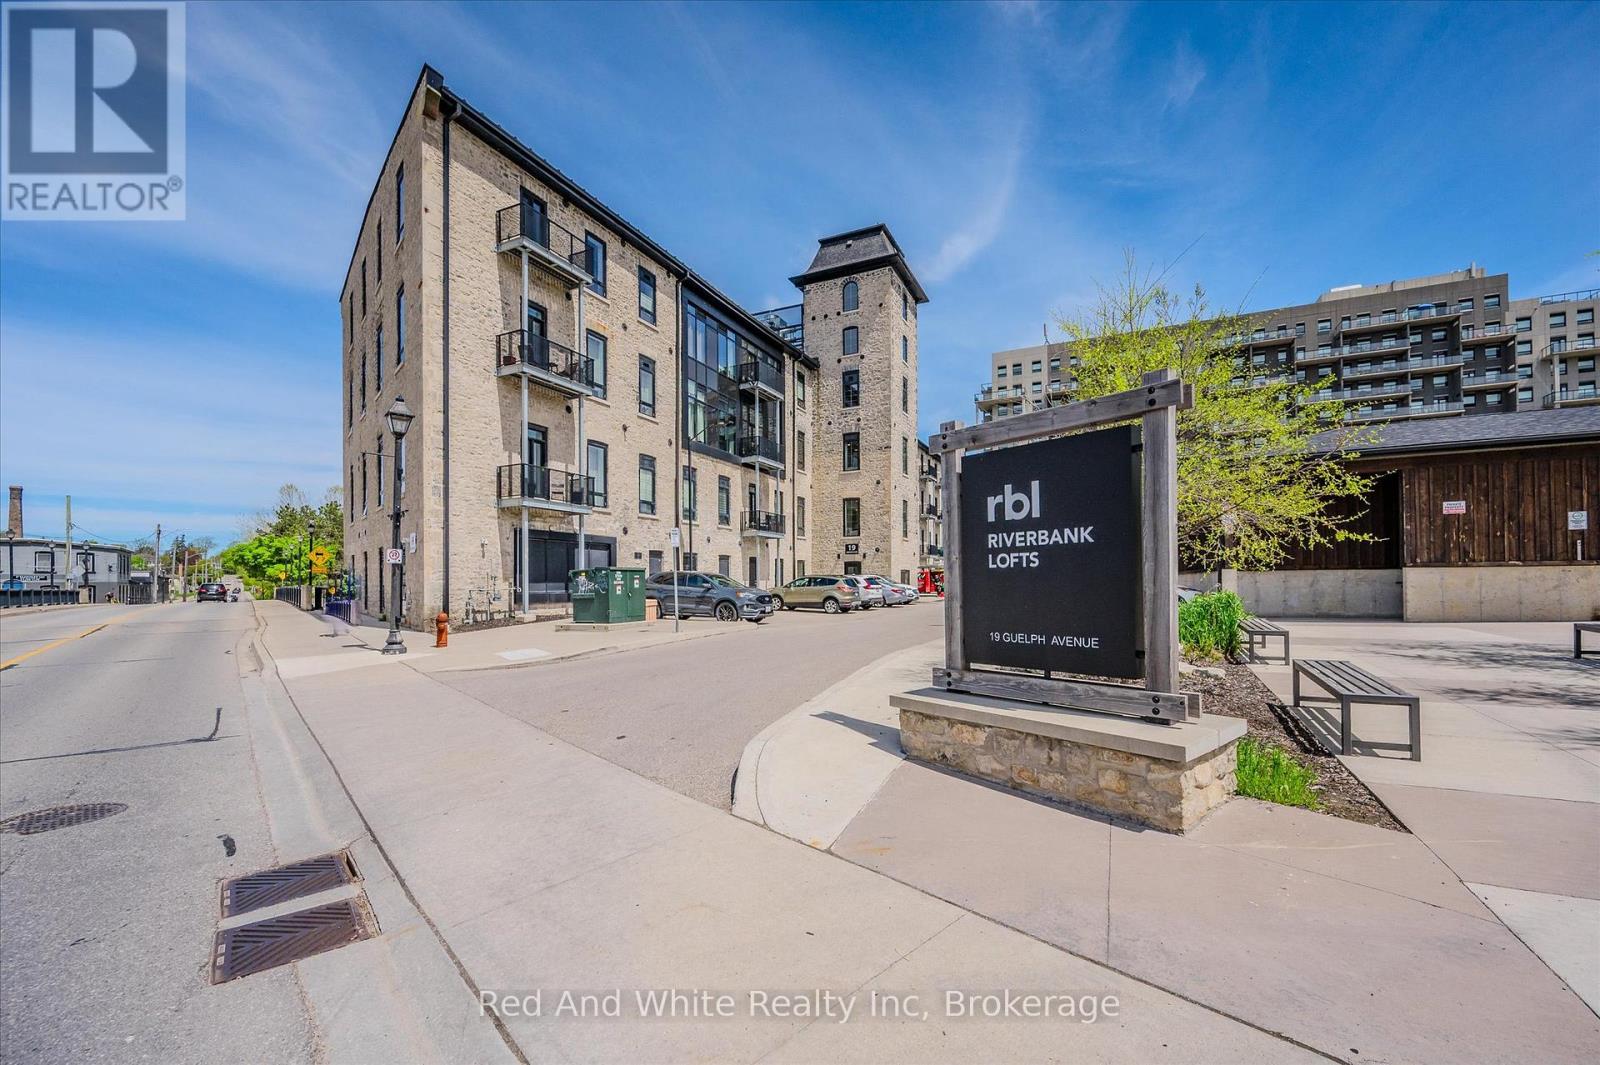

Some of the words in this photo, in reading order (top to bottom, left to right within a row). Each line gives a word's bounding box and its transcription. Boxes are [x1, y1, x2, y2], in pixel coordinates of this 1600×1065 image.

[987, 480, 1041, 522] rbl
[988, 526, 1095, 549] RIVERBANK
[988, 552, 1040, 569] LOFTS
[989, 631, 1000, 642] 19
[1002, 632, 1046, 645] GUELPH
[1051, 635, 1100, 649] AVENUE
